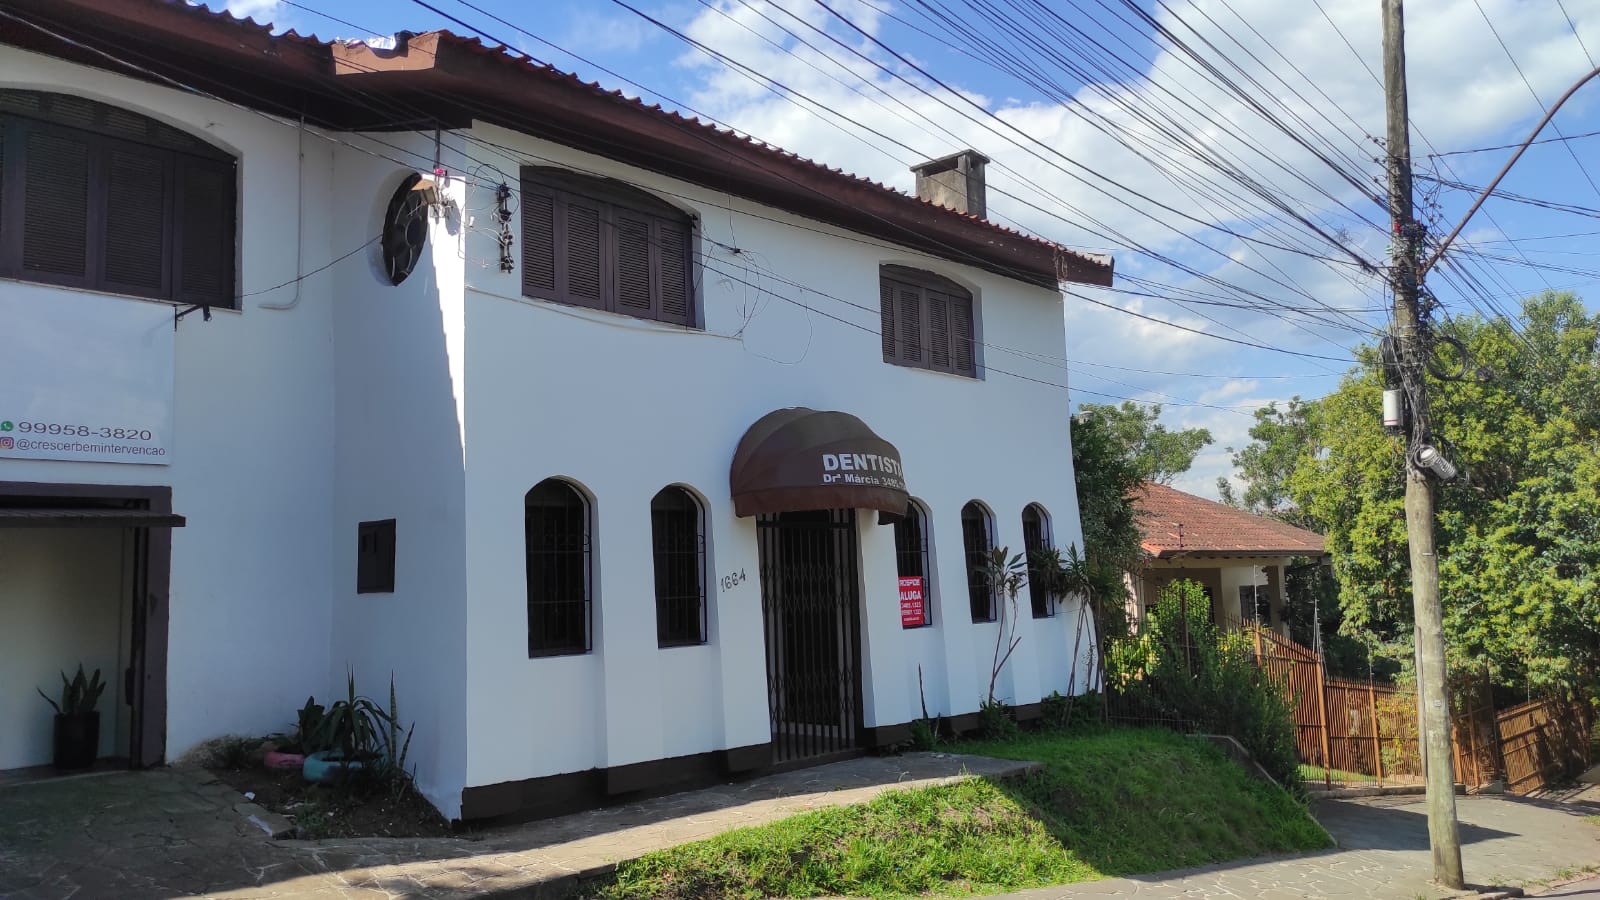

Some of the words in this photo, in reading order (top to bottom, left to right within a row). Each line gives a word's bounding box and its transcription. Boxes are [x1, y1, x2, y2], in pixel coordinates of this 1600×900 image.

[18, 421, 152, 441] 99958-3820
[16, 438, 166, 456] @crescerbemintervencao
[844, 473, 880, 485] Márcia
[720, 567, 746, 593] 1664
[900, 590, 922, 601] ALUGA
